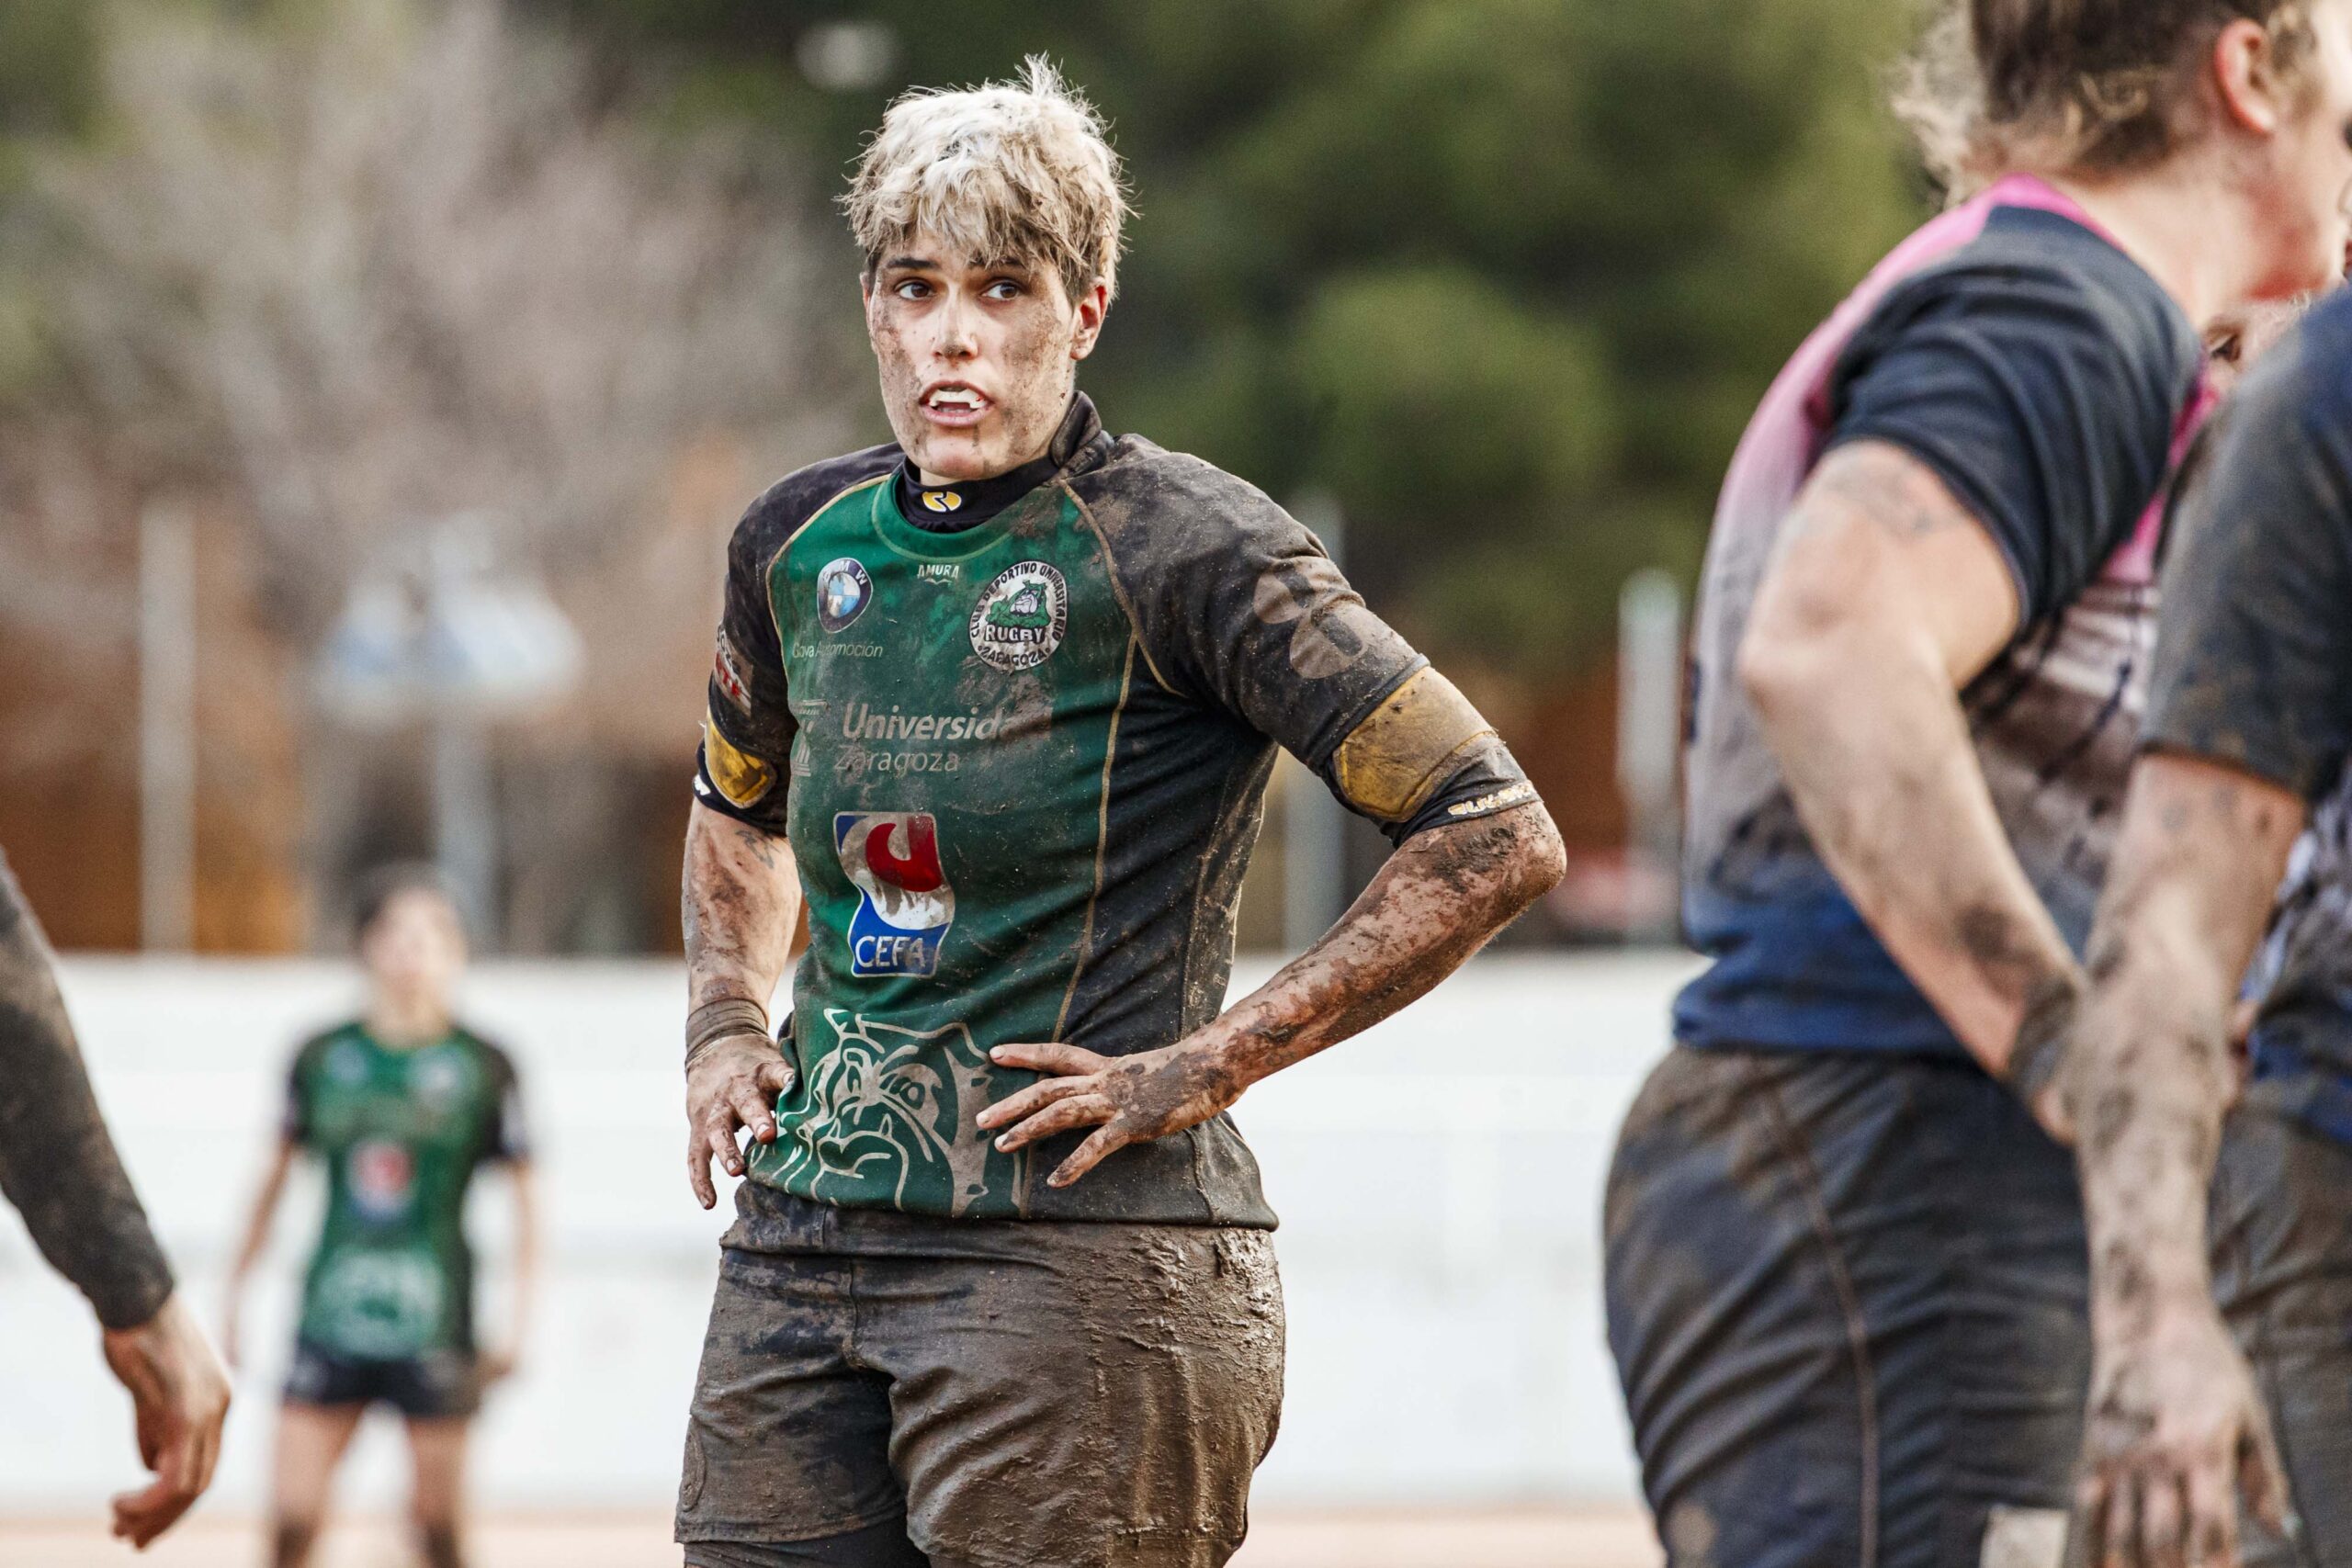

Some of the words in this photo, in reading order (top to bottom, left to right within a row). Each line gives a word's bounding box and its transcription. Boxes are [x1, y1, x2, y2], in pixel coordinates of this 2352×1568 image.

[917, 564, 960, 580] AMURA
[982, 562, 1037, 602] DEPORTIVO
[985, 625, 1044, 642] RUGBY
[792, 642, 814, 661] Goya
[842, 702, 1053, 741] Universid
[854, 935, 925, 969] CEFA
